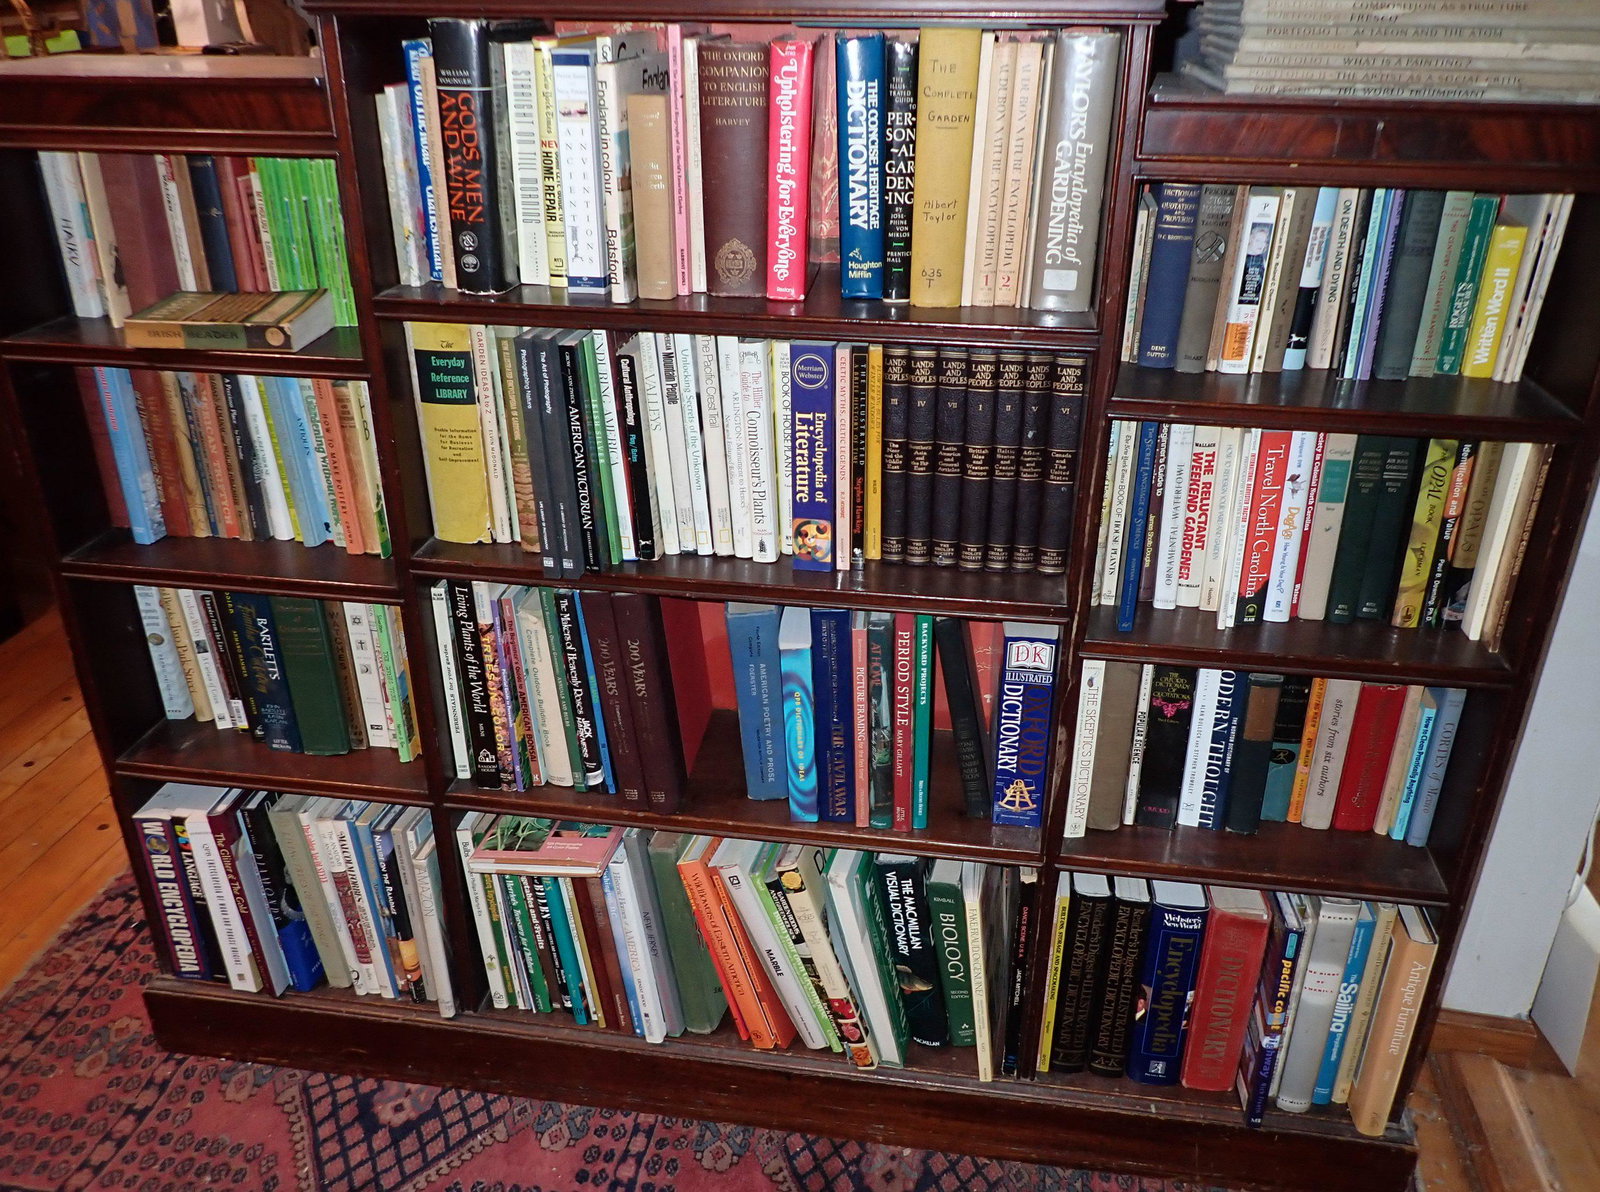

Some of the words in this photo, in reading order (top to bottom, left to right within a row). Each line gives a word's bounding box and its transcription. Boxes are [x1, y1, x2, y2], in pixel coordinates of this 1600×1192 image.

[700, 66, 769, 77] COMPANION
[703, 52, 720, 61] THE
[724, 52, 764, 61] OXFORD
[702, 96, 766, 107] LITERATURE
[704, 82, 718, 92] TO
[720, 82, 765, 92] ENGLISH
[868, 79, 878, 107] THE
[1069, 39, 1097, 140] TAYLOR'S
[1337, 87, 1357, 97] THE
[1362, 87, 1405, 98] WORLD
[1409, 87, 1486, 99] TRIUMPHANT
[441, 92, 460, 149] AND
[597, 80, 609, 135] England
[715, 117, 750, 127] HARVEY
[774, 59, 798, 174] Upholstering
[928, 110, 970, 124] GARDEN
[458, 92, 480, 162] GODS,
[869, 110, 878, 164] CONCISE
[602, 137, 609, 150] in
[846, 79, 867, 229] DICTIONARY
[542, 151, 556, 181] HOME
[602, 152, 612, 196] colour
[447, 152, 466, 221] WINE
[464, 169, 485, 224] MEN,
[776, 174, 797, 205] for
[869, 168, 880, 229] HERITAGE
[1067, 141, 1093, 245] Encyclopedia
[255, 190, 270, 236] MYTHOLOGY
[544, 185, 557, 222] REPAIR
[922, 212, 957, 224] Taylor
[1046, 140, 1072, 265] GARDENING
[1342, 199, 1352, 215] ON
[61, 218, 81, 267] HAIKU
[773, 205, 797, 281] Everyone
[1336, 216, 1351, 249] DEATH
[608, 229, 621, 285] Batsford
[848, 260, 882, 270] Houghton
[1063, 248, 1081, 265] of
[1333, 251, 1346, 271] AND
[1494, 268, 1510, 276] II
[848, 269, 871, 279] Mifflin
[1328, 273, 1343, 303] DYING
[1485, 280, 1508, 315] Word
[476, 332, 486, 366] GARDEN
[701, 335, 711, 352] The
[1147, 351, 1168, 359] DUTTON
[1152, 345, 1166, 353] DENT
[1473, 317, 1498, 364] Written
[430, 373, 469, 383] Reference
[431, 356, 465, 370] Everyday
[620, 359, 631, 384] Cultural
[662, 352, 677, 382] Mountain
[703, 354, 717, 385] Pacific
[797, 364, 824, 372] Merriam
[799, 372, 823, 380] Webster
[1057, 367, 1081, 376] LANDS
[435, 388, 468, 399] LIBRARY
[480, 368, 489, 393] IDEAS
[666, 383, 679, 405] People
[1052, 382, 1083, 391] PEOPLES
[1061, 375, 1077, 384] AND
[543, 380, 552, 414] Photography
[623, 385, 636, 426] Anthropology
[645, 373, 661, 431] VALLEYS
[706, 387, 718, 411] Crest
[322, 414, 331, 434] HOW
[708, 412, 719, 428] Trail
[297, 417, 310, 456] ANTIQUES
[328, 439, 334, 449] TO
[569, 406, 585, 468] AMERICAN
[746, 410, 765, 488] Connoisseur's
[814, 412, 826, 485] Encyclopedia
[330, 452, 339, 475] MAKE
[795, 411, 813, 503] Literature
[1203, 451, 1215, 475] THE
[1261, 444, 1285, 490] Travel
[1452, 444, 1472, 497] Identification
[336, 480, 347, 515] POTTERY
[816, 487, 827, 503] of
[1186, 452, 1204, 513] WEEKEND
[1427, 466, 1447, 500] OPAL
[576, 469, 592, 529] VICTORIAN
[753, 490, 768, 524] Plants
[1426, 504, 1436, 523] BOOK
[1448, 501, 1459, 515] and
[1194, 482, 1212, 551] RELUCTANT
[1255, 494, 1273, 536] North
[1443, 518, 1456, 540] Value
[1178, 516, 1195, 581] GARDENER
[1245, 540, 1269, 598] Carolina
[455, 587, 468, 618] Living
[461, 621, 474, 651] Plants
[465, 654, 478, 663] of
[468, 665, 481, 679] the
[897, 631, 911, 682] PERIOD
[759, 663, 769, 704] AMERICAN
[856, 667, 866, 702] PICTURE
[1005, 673, 1053, 683] ILLUSTRATED
[472, 682, 487, 713] World
[897, 686, 908, 726] STYLE
[1087, 686, 1099, 706] THE
[519, 691, 531, 731] AMERICAN
[527, 734, 537, 762] BONSAI
[762, 707, 771, 737] POETRY
[857, 704, 867, 741] FRAMING
[1135, 711, 1147, 737] POPULAR
[1330, 699, 1345, 726] stories
[1425, 717, 1433, 728] How
[997, 684, 1023, 773] DICTIONARY
[1082, 709, 1097, 757] SKEPTIC'S
[1326, 728, 1339, 749] from
[1418, 735, 1428, 751] Clean
[1132, 739, 1143, 765] SCIENCE
[1323, 751, 1334, 763] six
[1410, 751, 1426, 779] Practically
[767, 758, 775, 783] PROSE
[1198, 741, 1225, 828] THOUGHT
[1316, 765, 1331, 797] authors
[1073, 760, 1092, 820] DICTIONARY
[1403, 779, 1416, 804] Anything
[462, 841, 470, 858] Bulbs
[181, 851, 203, 898] LANGUAGE
[885, 872, 898, 901] VISUAL
[901, 879, 914, 896] THE
[415, 868, 435, 917] AMAZON
[690, 872, 715, 920] Wildflowers
[154, 883, 200, 972] ENCYCLOPEDIA
[710, 920, 721, 930] of
[890, 903, 909, 956] DICTIONARY
[903, 897, 922, 949] MACMILLAN
[1163, 920, 1179, 928] New
[1180, 922, 1201, 930] World
[1164, 913, 1202, 923] Webster's
[713, 930, 733, 961] Eastern
[939, 913, 965, 982] BIOLOGY
[765, 949, 784, 977] MARBLE
[723, 962, 745, 996] America
[1276, 960, 1293, 998] pacific
[1401, 961, 1427, 1004] Antique
[1151, 938, 1194, 1052] Encyclopedia
[1329, 982, 1359, 1033] Sailing
[1388, 1007, 1412, 1056] Furniture
